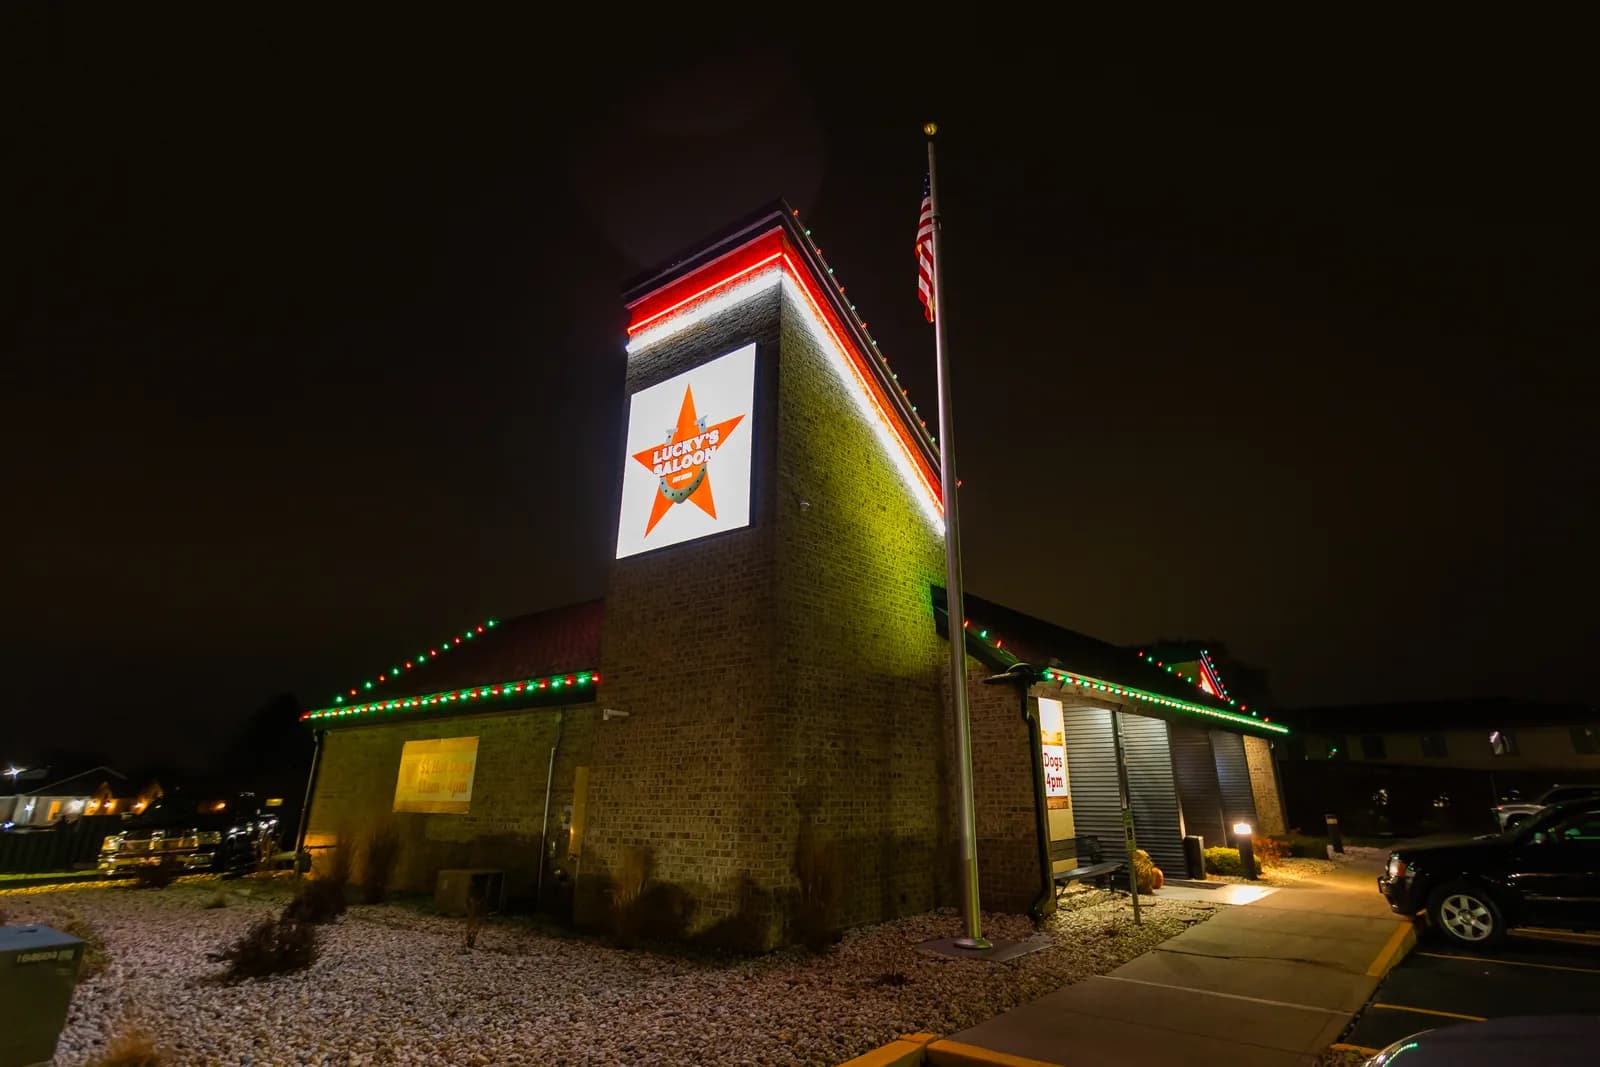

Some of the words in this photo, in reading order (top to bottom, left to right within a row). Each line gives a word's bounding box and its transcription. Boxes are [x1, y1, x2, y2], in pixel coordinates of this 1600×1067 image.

[653, 429, 719, 465] LUCKY'S
[653, 446, 718, 477] SALOON
[1044, 752, 1063, 771] Dogs
[1046, 773, 1064, 792] 4pm
